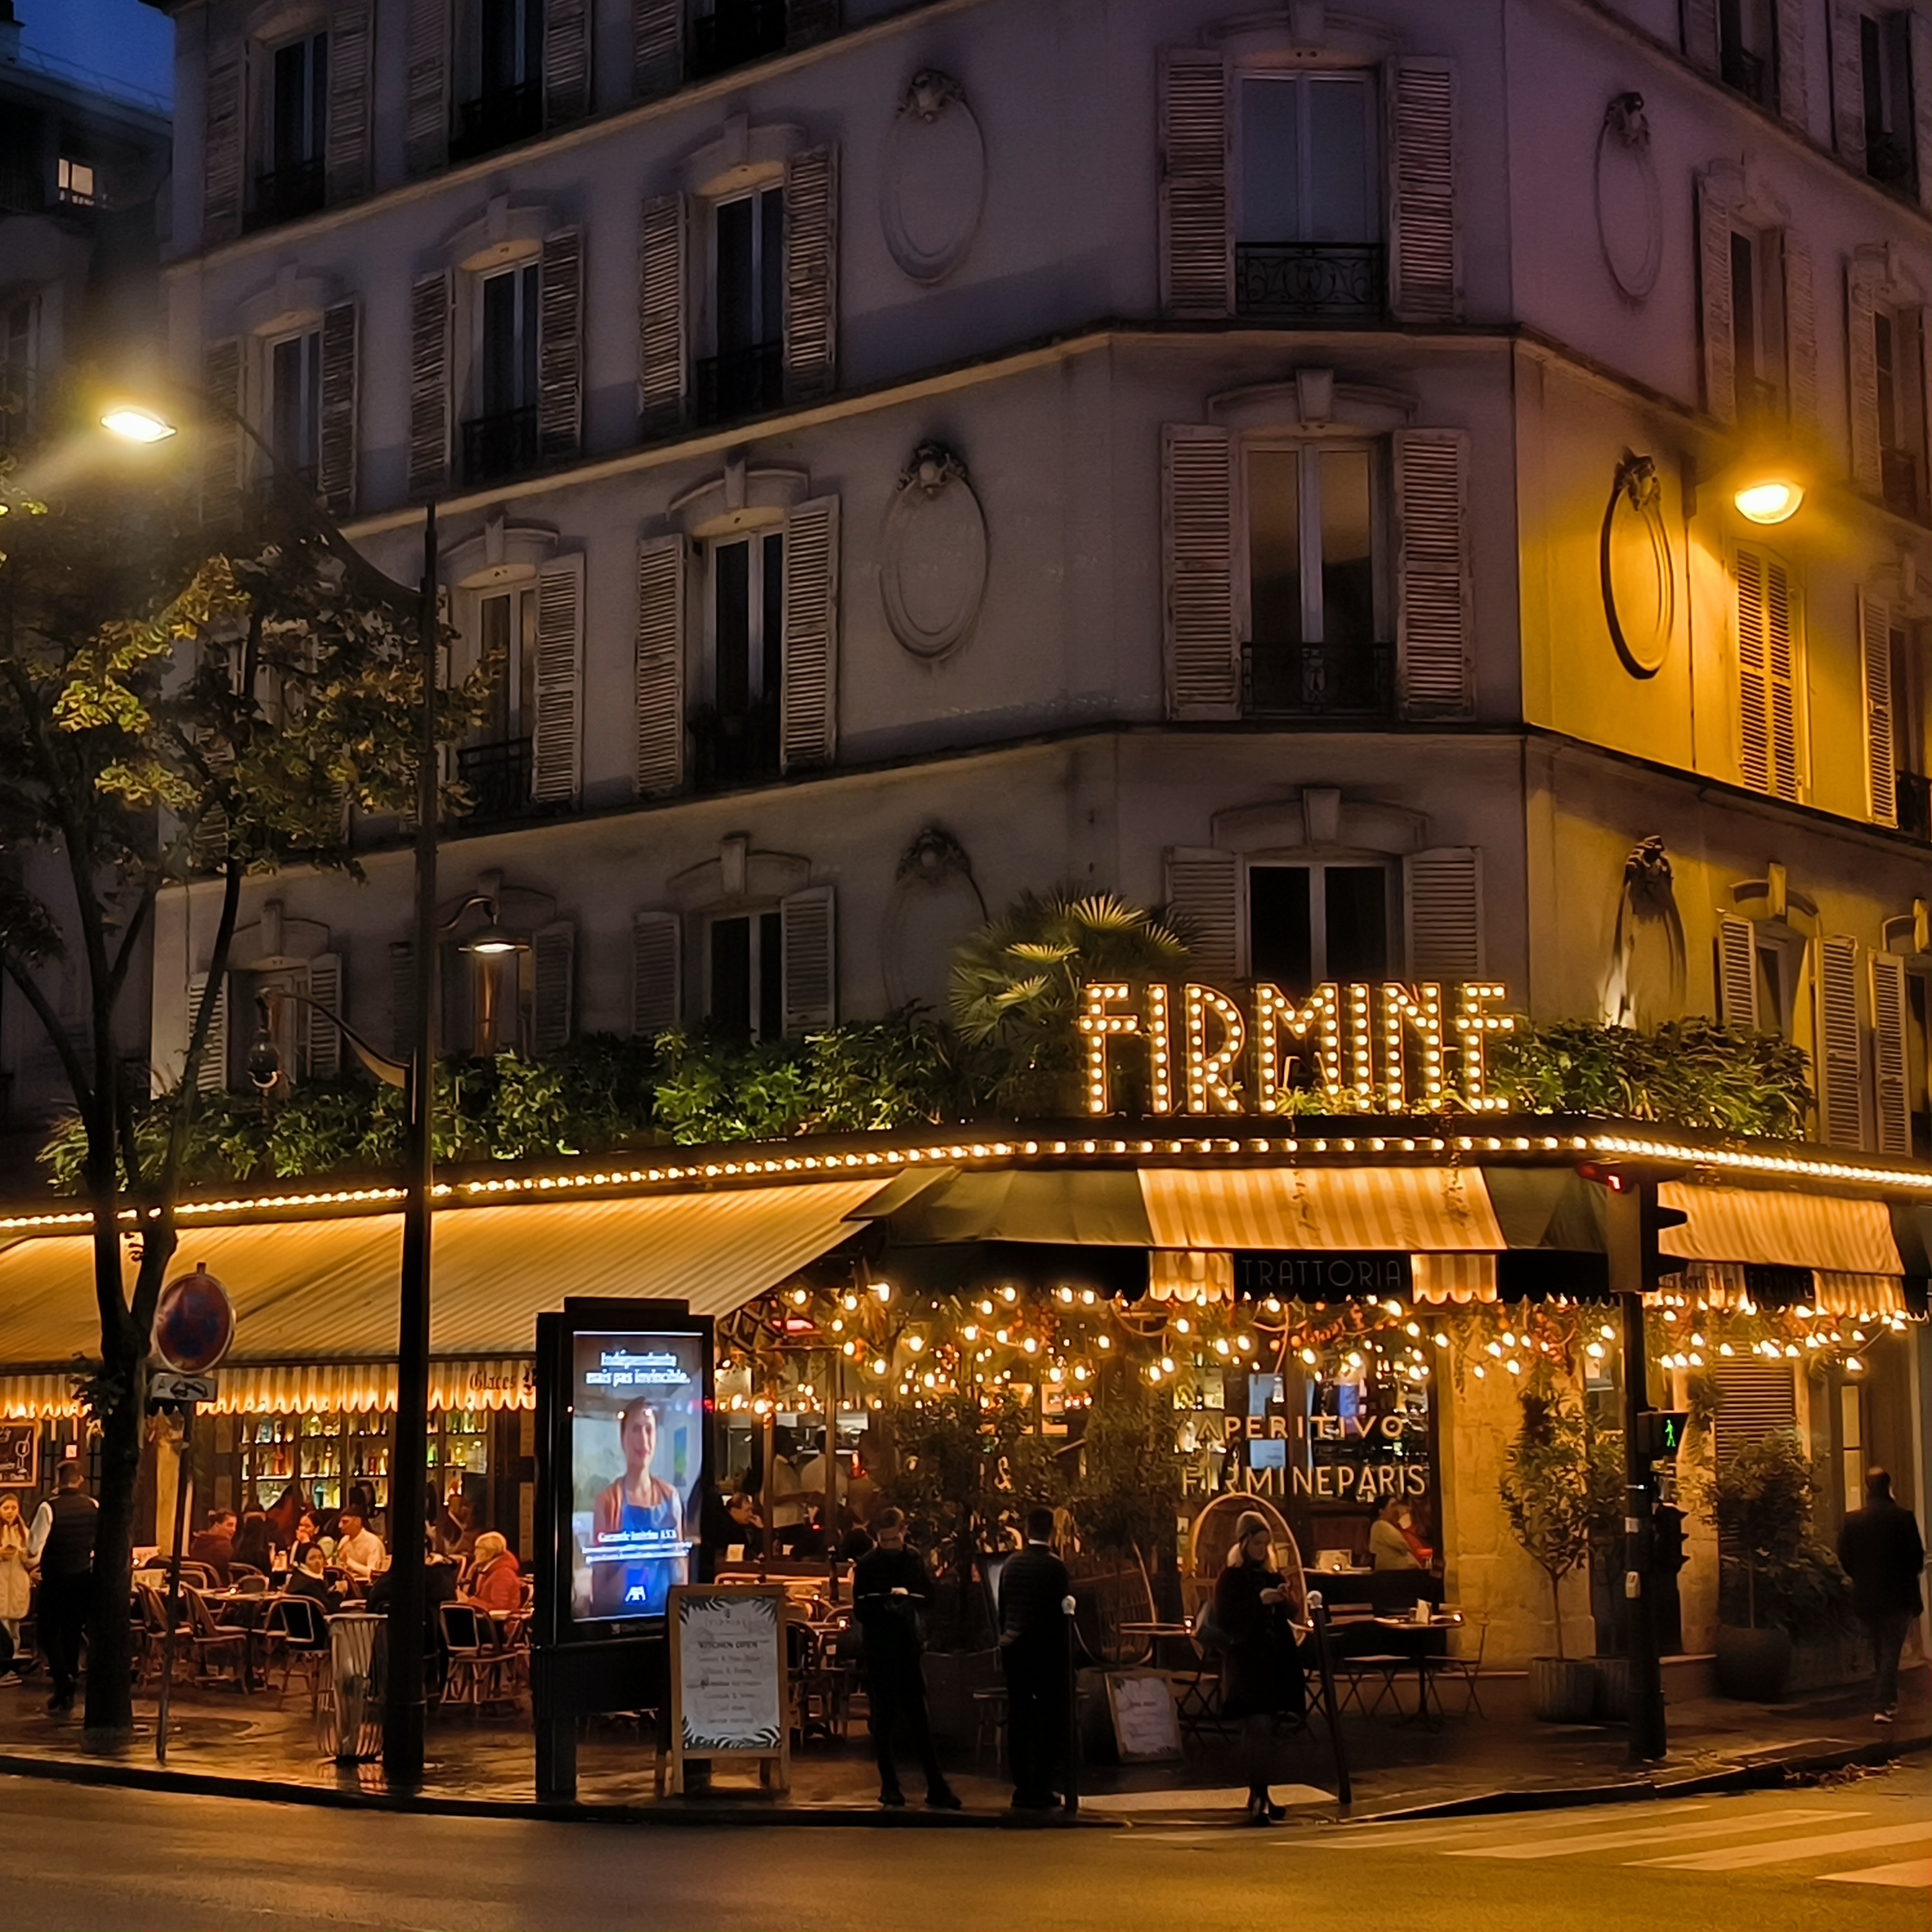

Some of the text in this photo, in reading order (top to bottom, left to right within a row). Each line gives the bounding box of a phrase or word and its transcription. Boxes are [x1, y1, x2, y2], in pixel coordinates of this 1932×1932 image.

[1078, 981, 1515, 1115] FIRMINE
[1241, 1259, 1401, 1287] TRATTORIA
[1196, 1415, 1404, 1440] APERITIVO
[1181, 1464, 1426, 1497] FIRMINEPARIS
